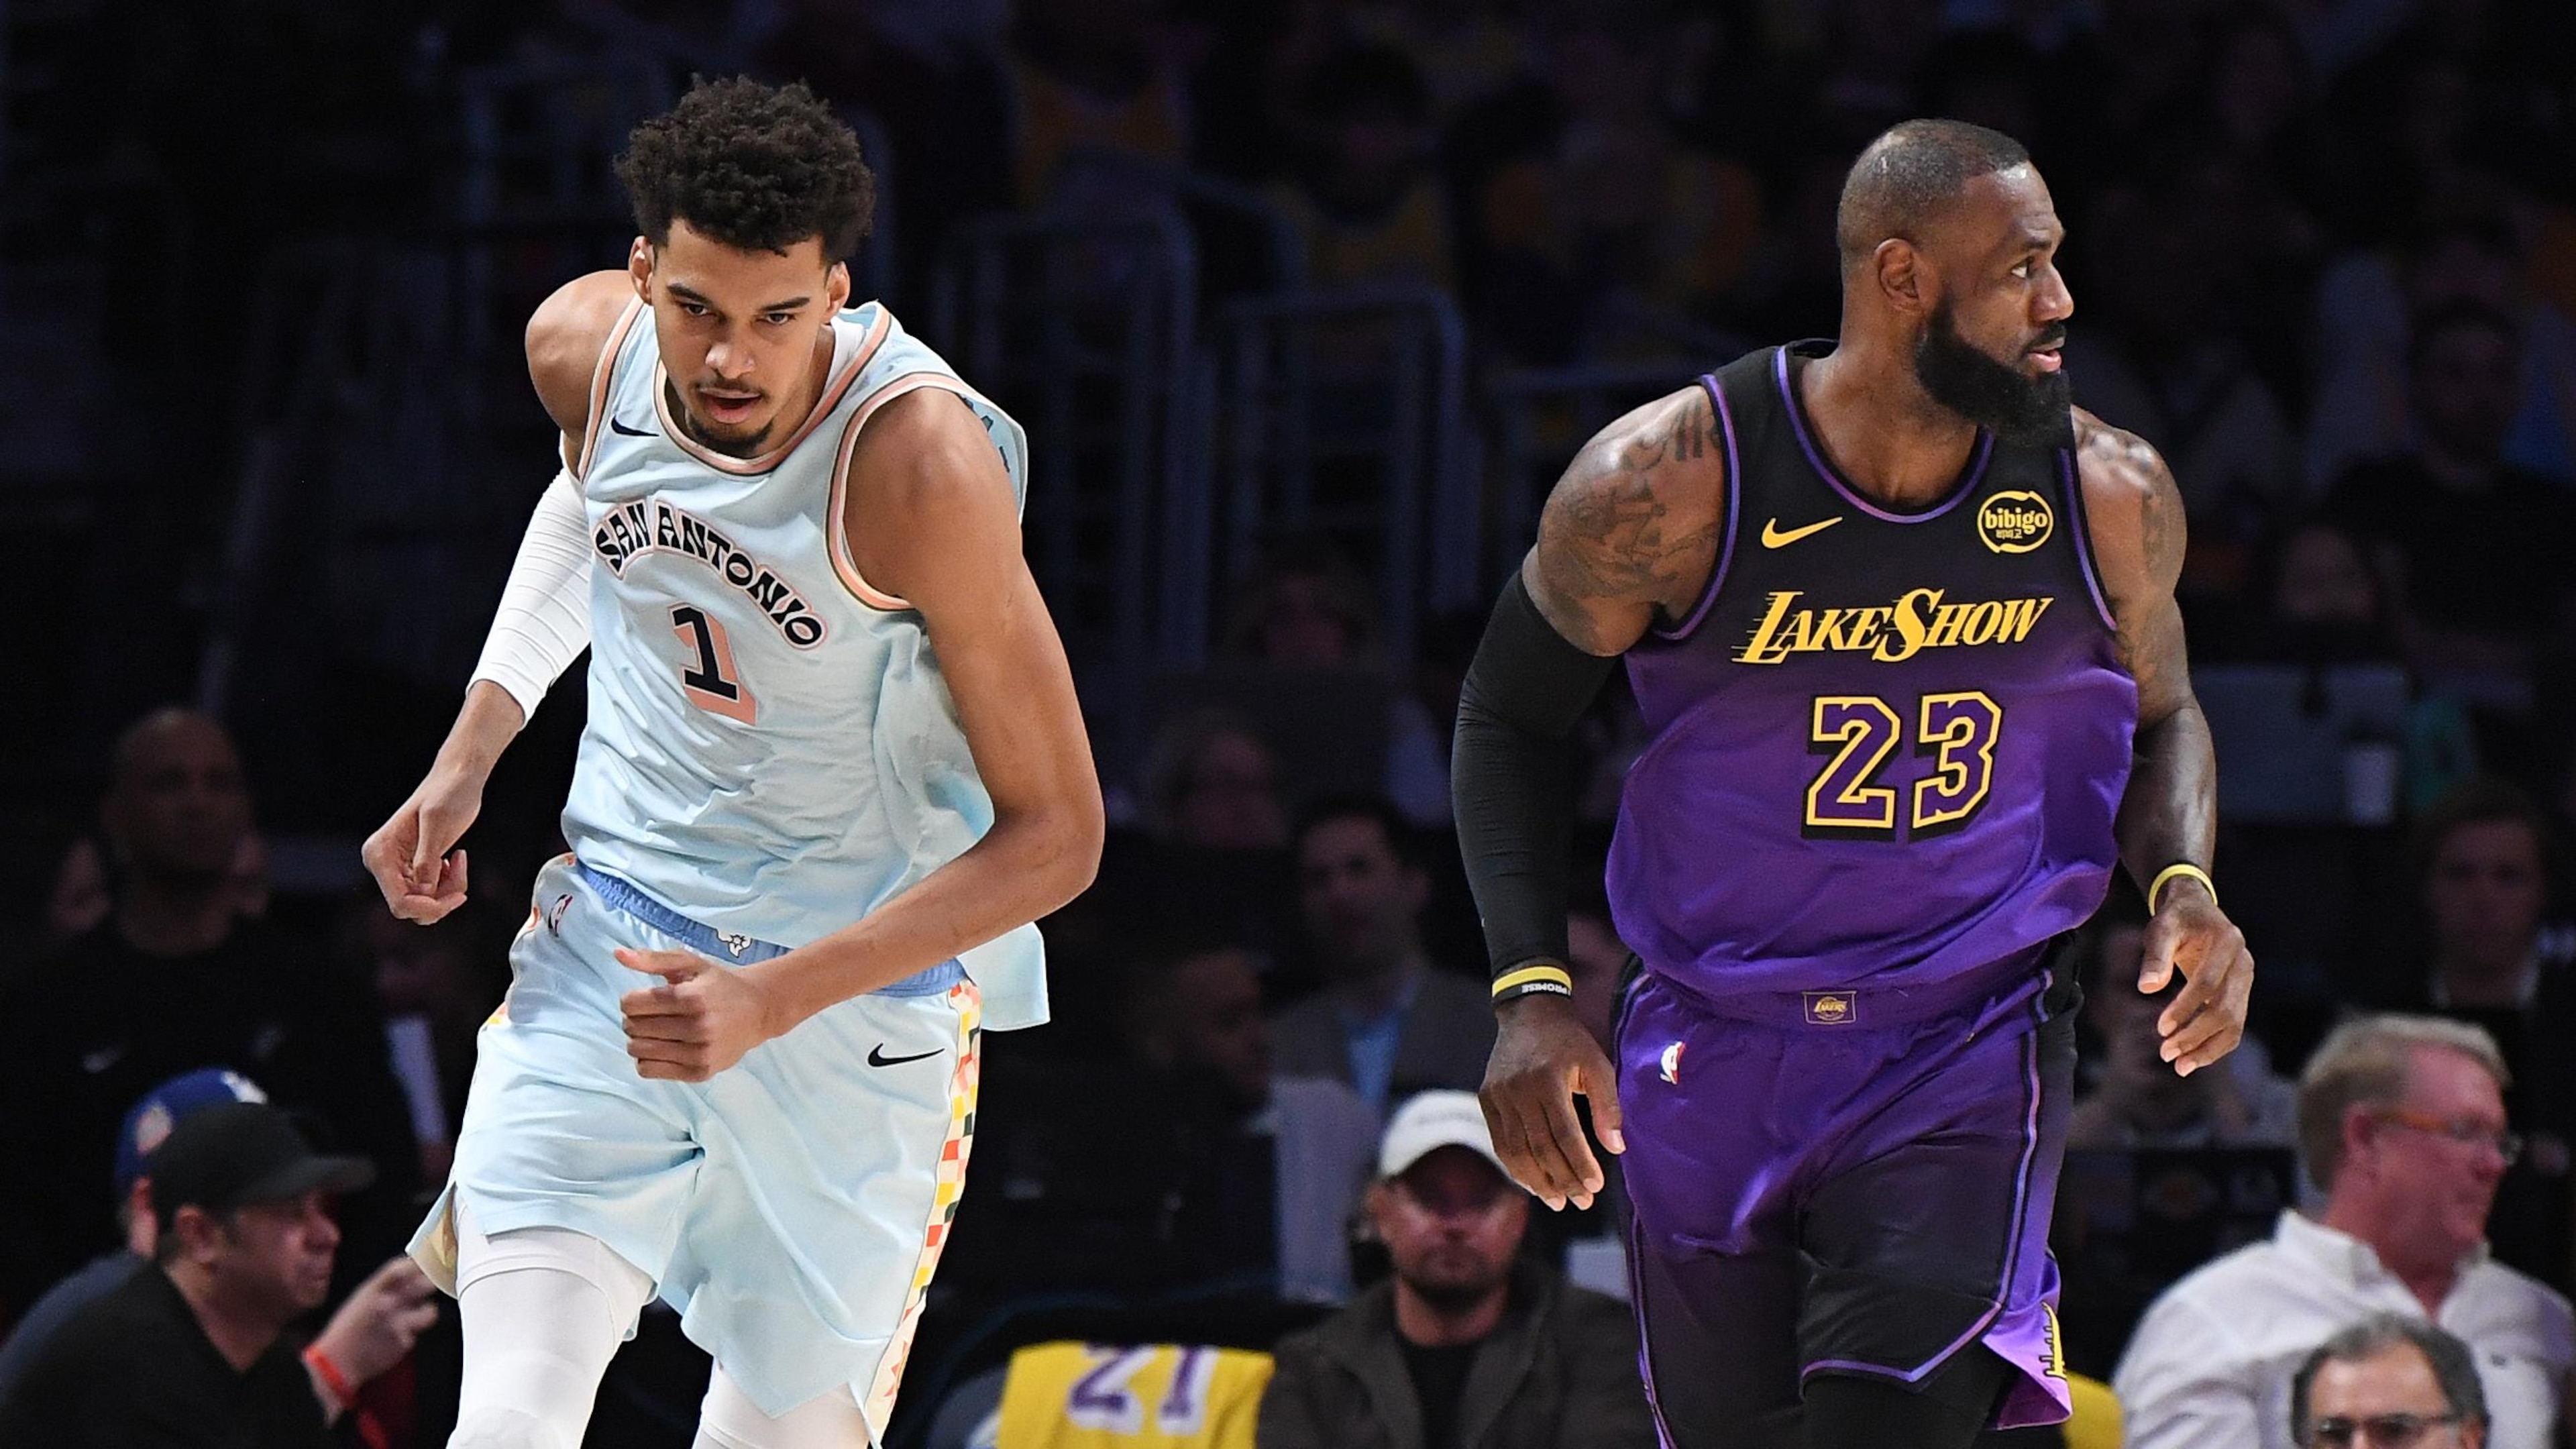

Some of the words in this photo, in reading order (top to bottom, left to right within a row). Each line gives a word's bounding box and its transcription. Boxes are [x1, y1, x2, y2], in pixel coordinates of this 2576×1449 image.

[593, 500, 653, 580] SAN
[653, 500, 828, 649] ANTONIO
[1984, 506, 2048, 535] bibigo
[669, 602, 757, 726] 1
[1802, 691, 2002, 840] 23
